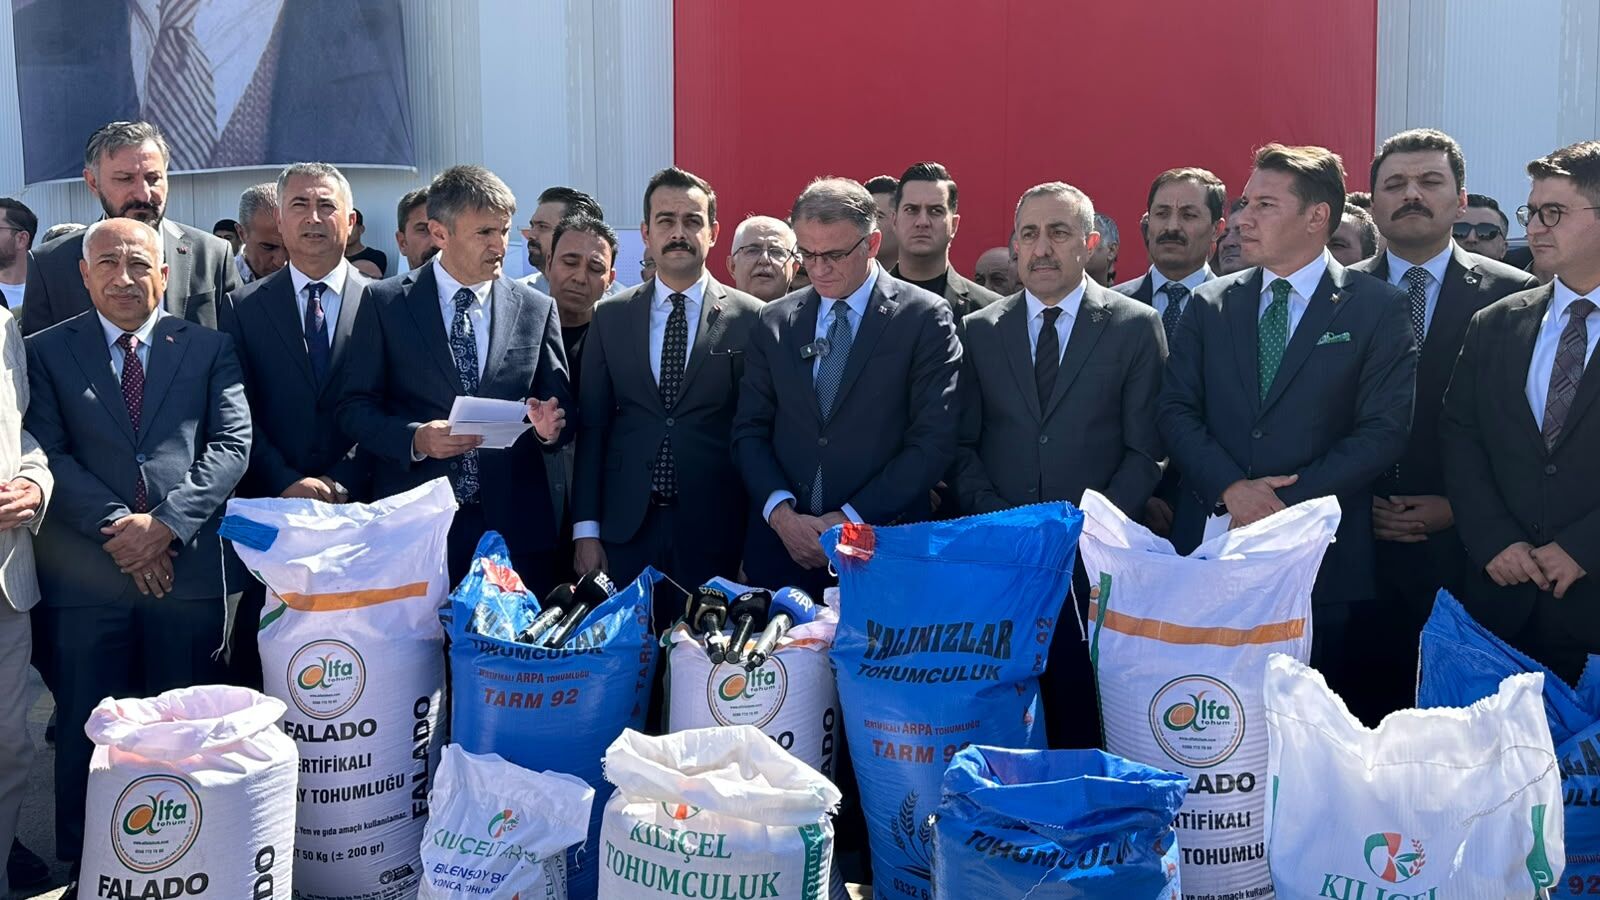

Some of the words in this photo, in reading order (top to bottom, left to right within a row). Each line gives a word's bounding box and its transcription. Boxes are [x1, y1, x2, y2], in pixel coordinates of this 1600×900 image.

[863, 618, 1013, 661] YALINIZLAR
[297, 653, 353, 691] alfa
[515, 672, 545, 684] ARPA
[857, 662, 1001, 684] TOHUMCULUK
[484, 687, 544, 709] TARM
[550, 688, 579, 707] 92
[1163, 693, 1230, 732] alfa
[284, 718, 377, 743] FALADO
[902, 722, 933, 736] ARPA
[821, 707, 835, 781] ADO
[872, 739, 935, 764] TARM
[943, 743, 971, 763] 9
[297, 753, 372, 774] RTİFİKALI
[411, 695, 431, 821] FALADO
[311, 773, 405, 804] TOHUMLUĞU
[1188, 771, 1256, 795] ADO
[122, 794, 187, 836] alfa
[338, 823, 363, 835] amaçlı
[302, 849, 314, 861] 50
[316, 851, 328, 864] Kg
[347, 845, 368, 859] 200
[370, 841, 385, 856] gr)
[629, 820, 733, 864] KILIÇEL
[1181, 842, 1265, 866] TOHUMLU
[604, 840, 782, 900] TOHUMCULUK
[97, 872, 210, 900] FALADO
[432, 878, 461, 892] YONCA
